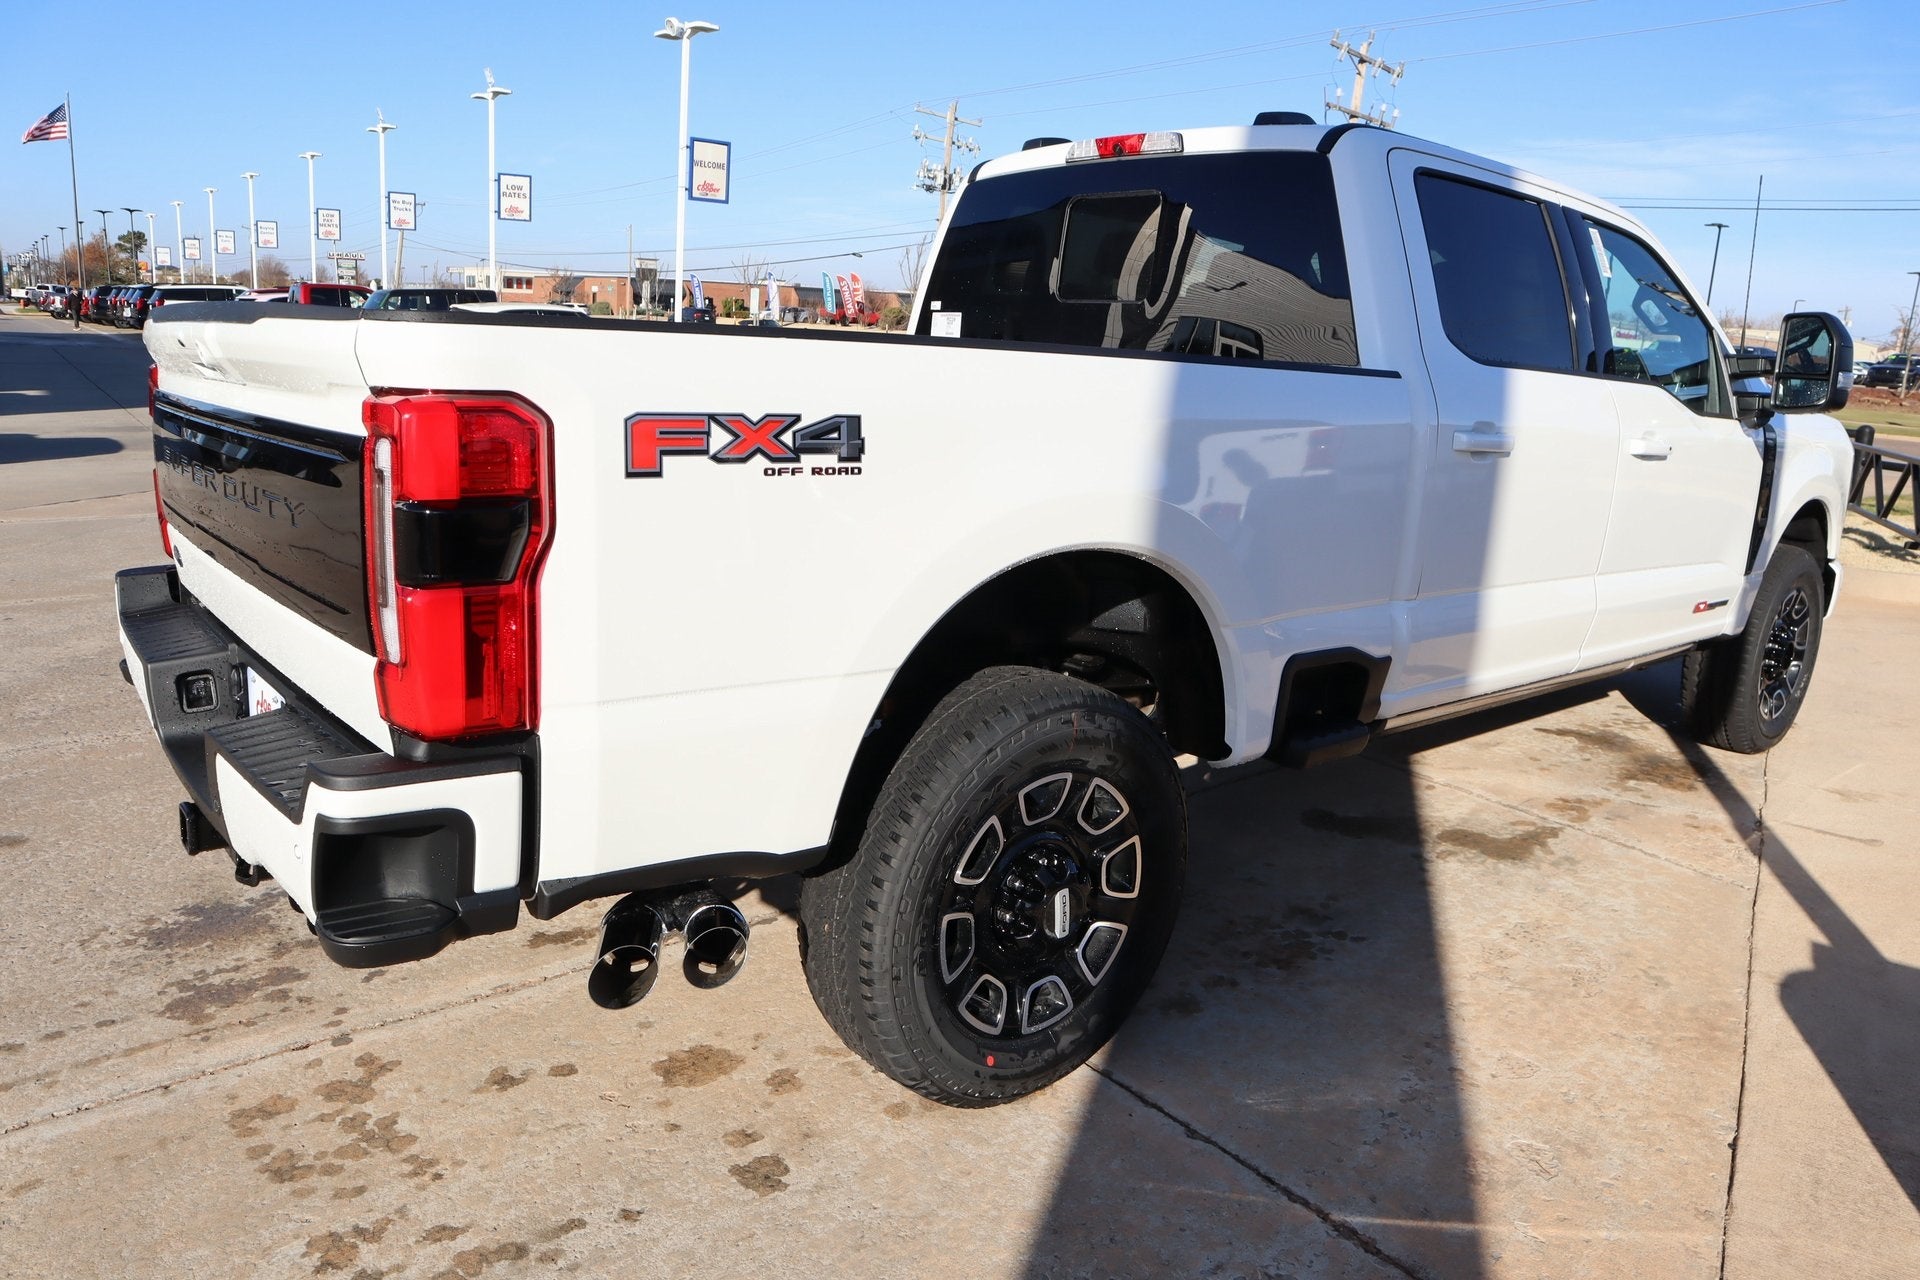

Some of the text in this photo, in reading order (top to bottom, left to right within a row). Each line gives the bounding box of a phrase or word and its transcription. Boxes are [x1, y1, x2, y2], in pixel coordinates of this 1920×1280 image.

[693, 160, 726, 171] WELCOME
[696, 184, 721, 193] Cooper
[703, 180, 715, 188] Joe
[502, 191, 527, 199] RATES
[840, 280, 855, 314] SAUNAS
[852, 281, 864, 310] SALE
[624, 412, 865, 479] FX4
[763, 466, 863, 477] OFF ROAD
[163, 444, 306, 528] SUPER DUTY
